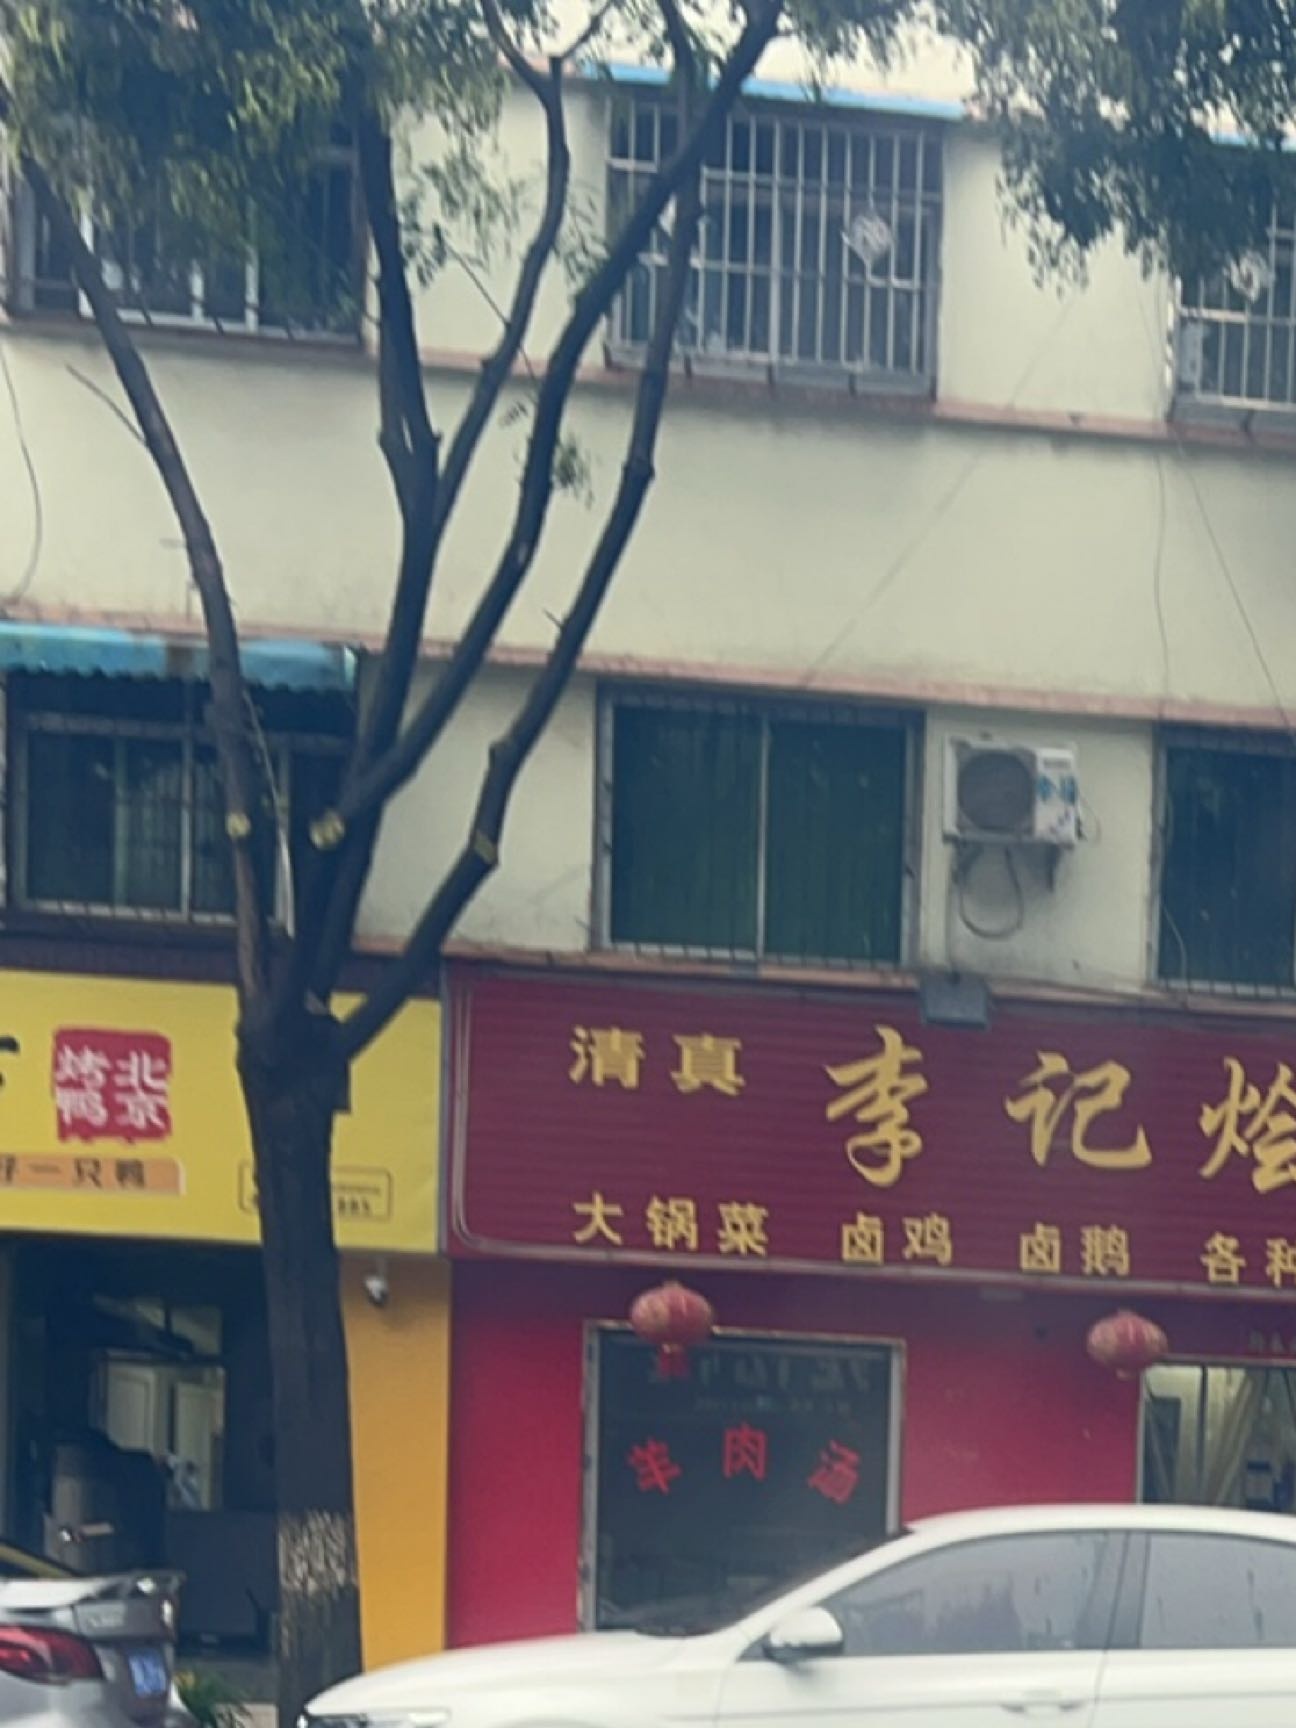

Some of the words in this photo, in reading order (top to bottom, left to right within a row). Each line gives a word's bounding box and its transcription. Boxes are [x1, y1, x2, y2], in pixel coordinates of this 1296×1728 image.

[54, 1045, 109, 1128] 烤鸭
[112, 1049, 170, 1130] 北京
[568, 1024, 746, 1096] 清真
[572, 1192, 770, 1257] 大锅菜
[840, 1211, 954, 1266] 卤鸡
[1018, 1221, 1131, 1277] 卤鹅
[628, 1421, 862, 1505] 羊肉汤
